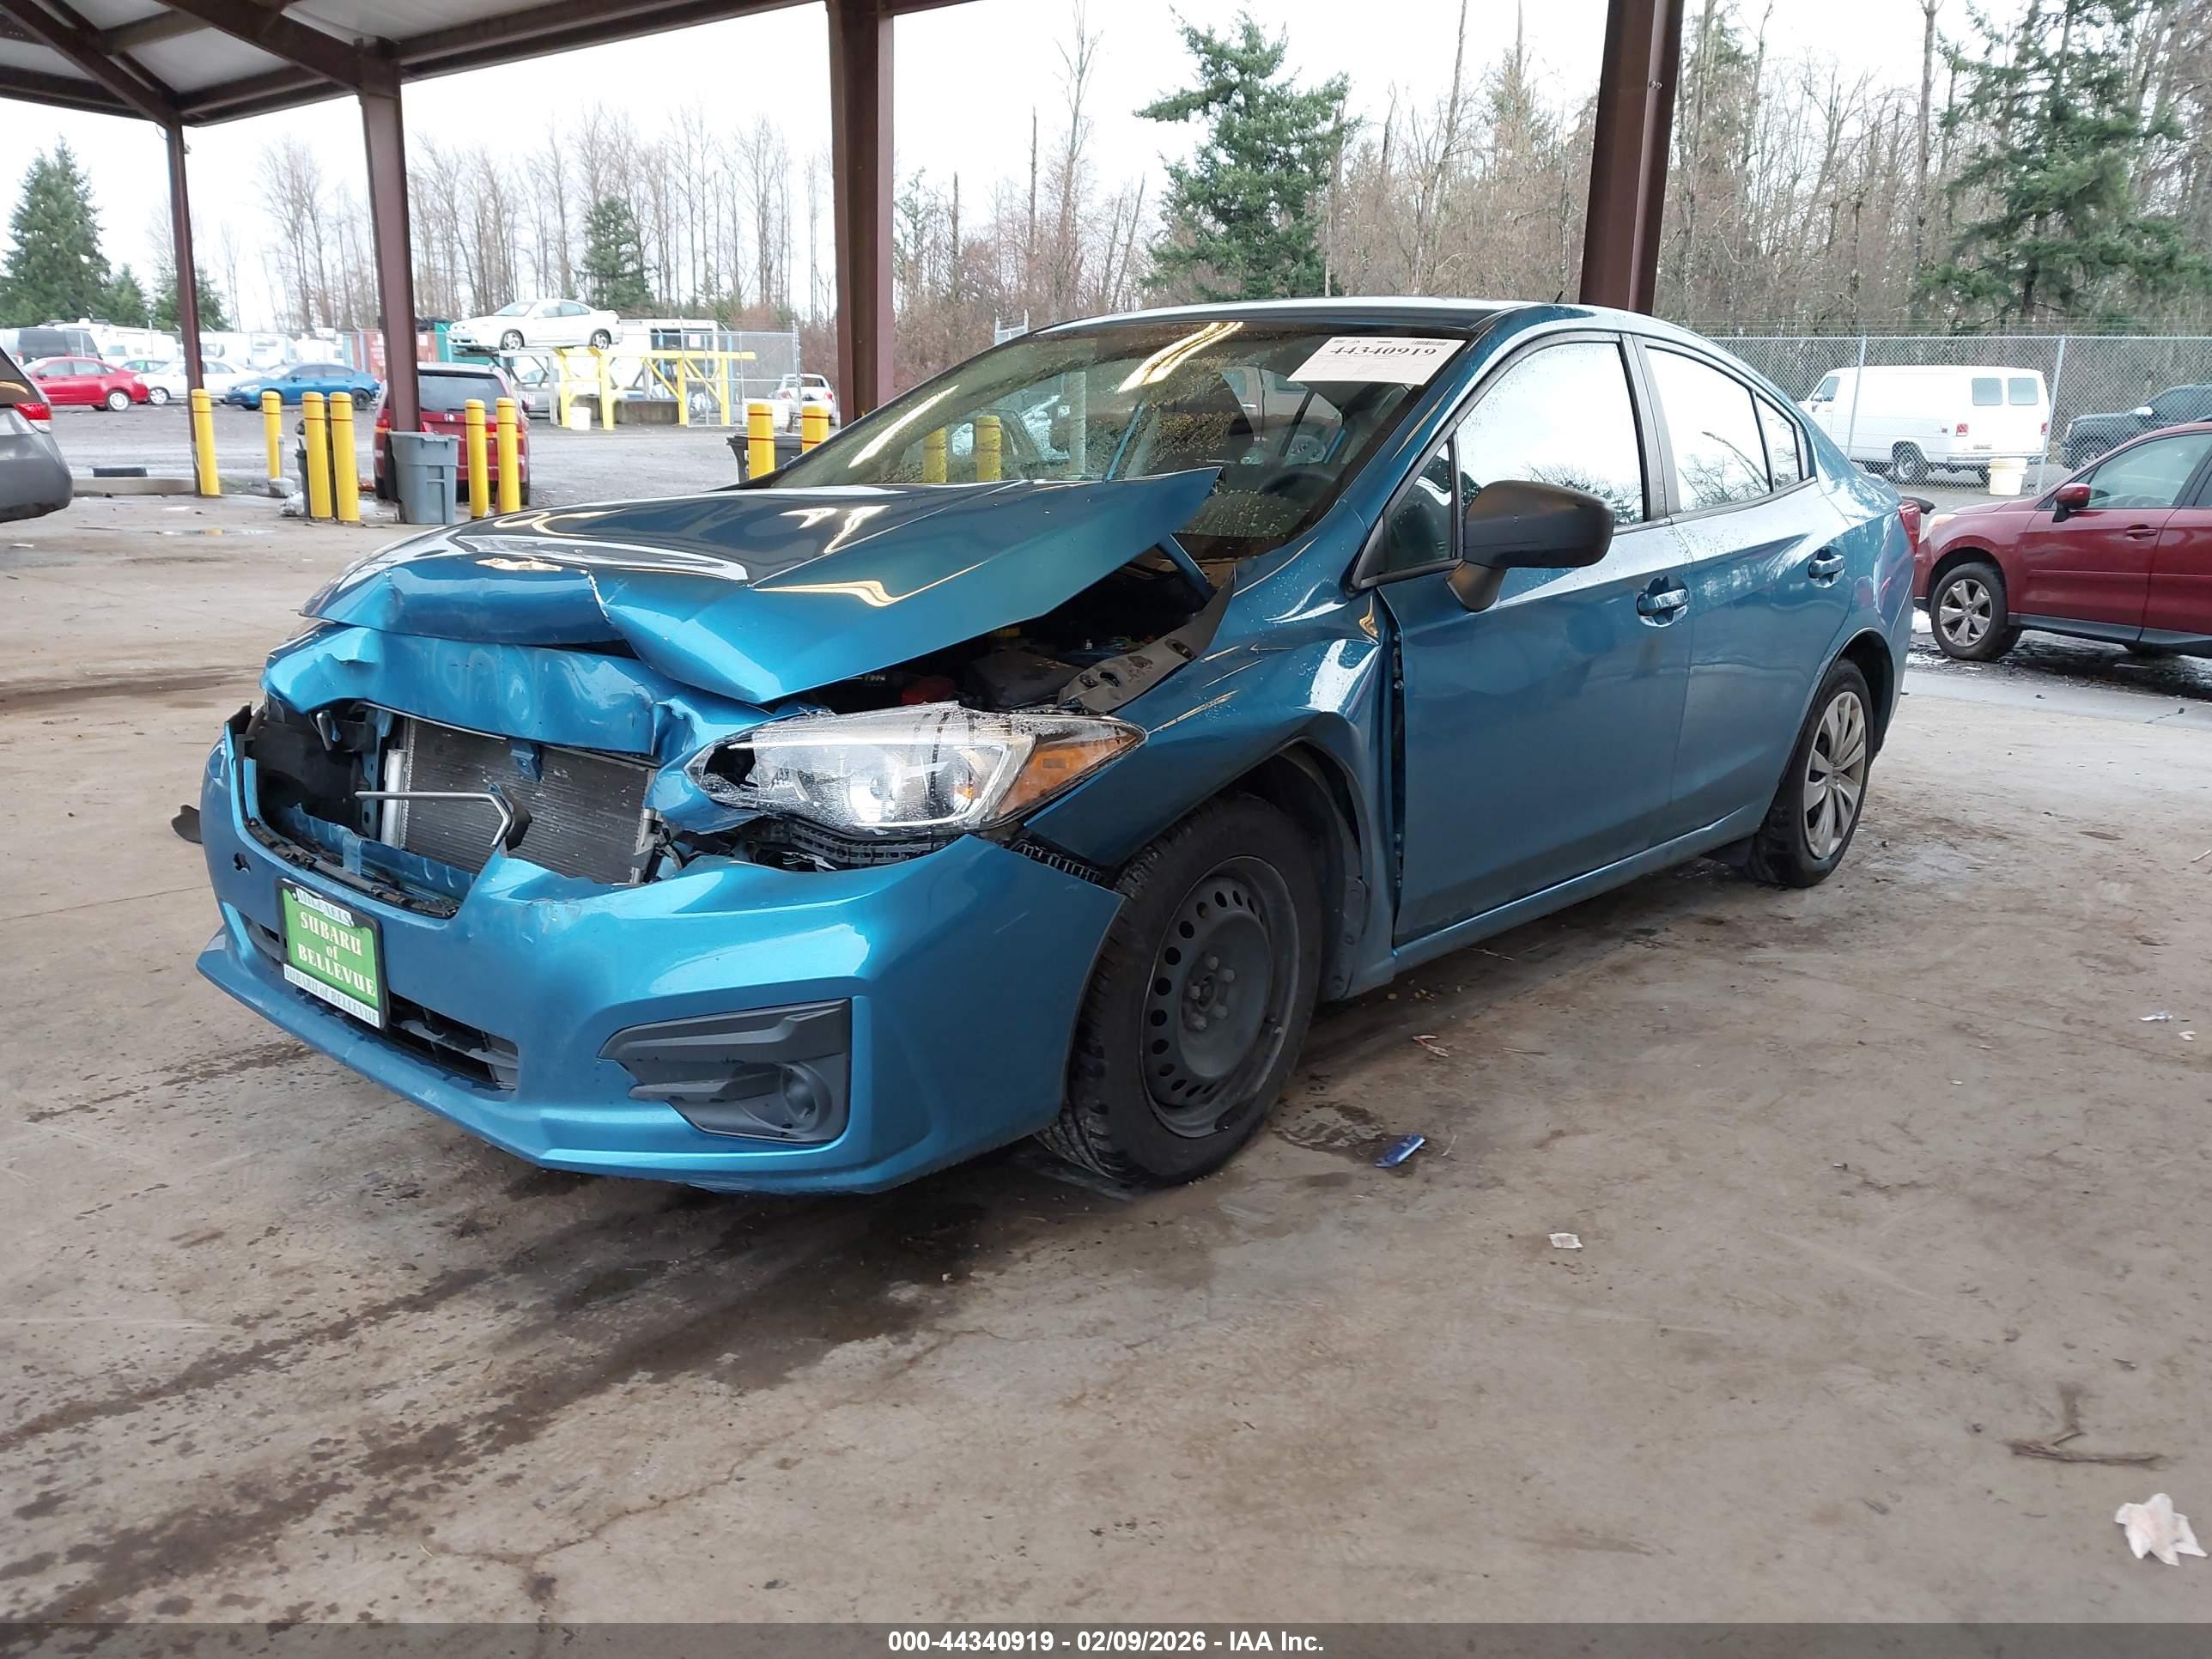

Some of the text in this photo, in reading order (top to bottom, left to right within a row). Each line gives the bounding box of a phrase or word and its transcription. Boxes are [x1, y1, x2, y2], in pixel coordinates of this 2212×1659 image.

[1330, 345, 1437, 356] 44340919
[300, 911, 362, 957] SUBARU
[325, 945, 338, 961] of
[296, 943, 375, 997] BELLEVUE
